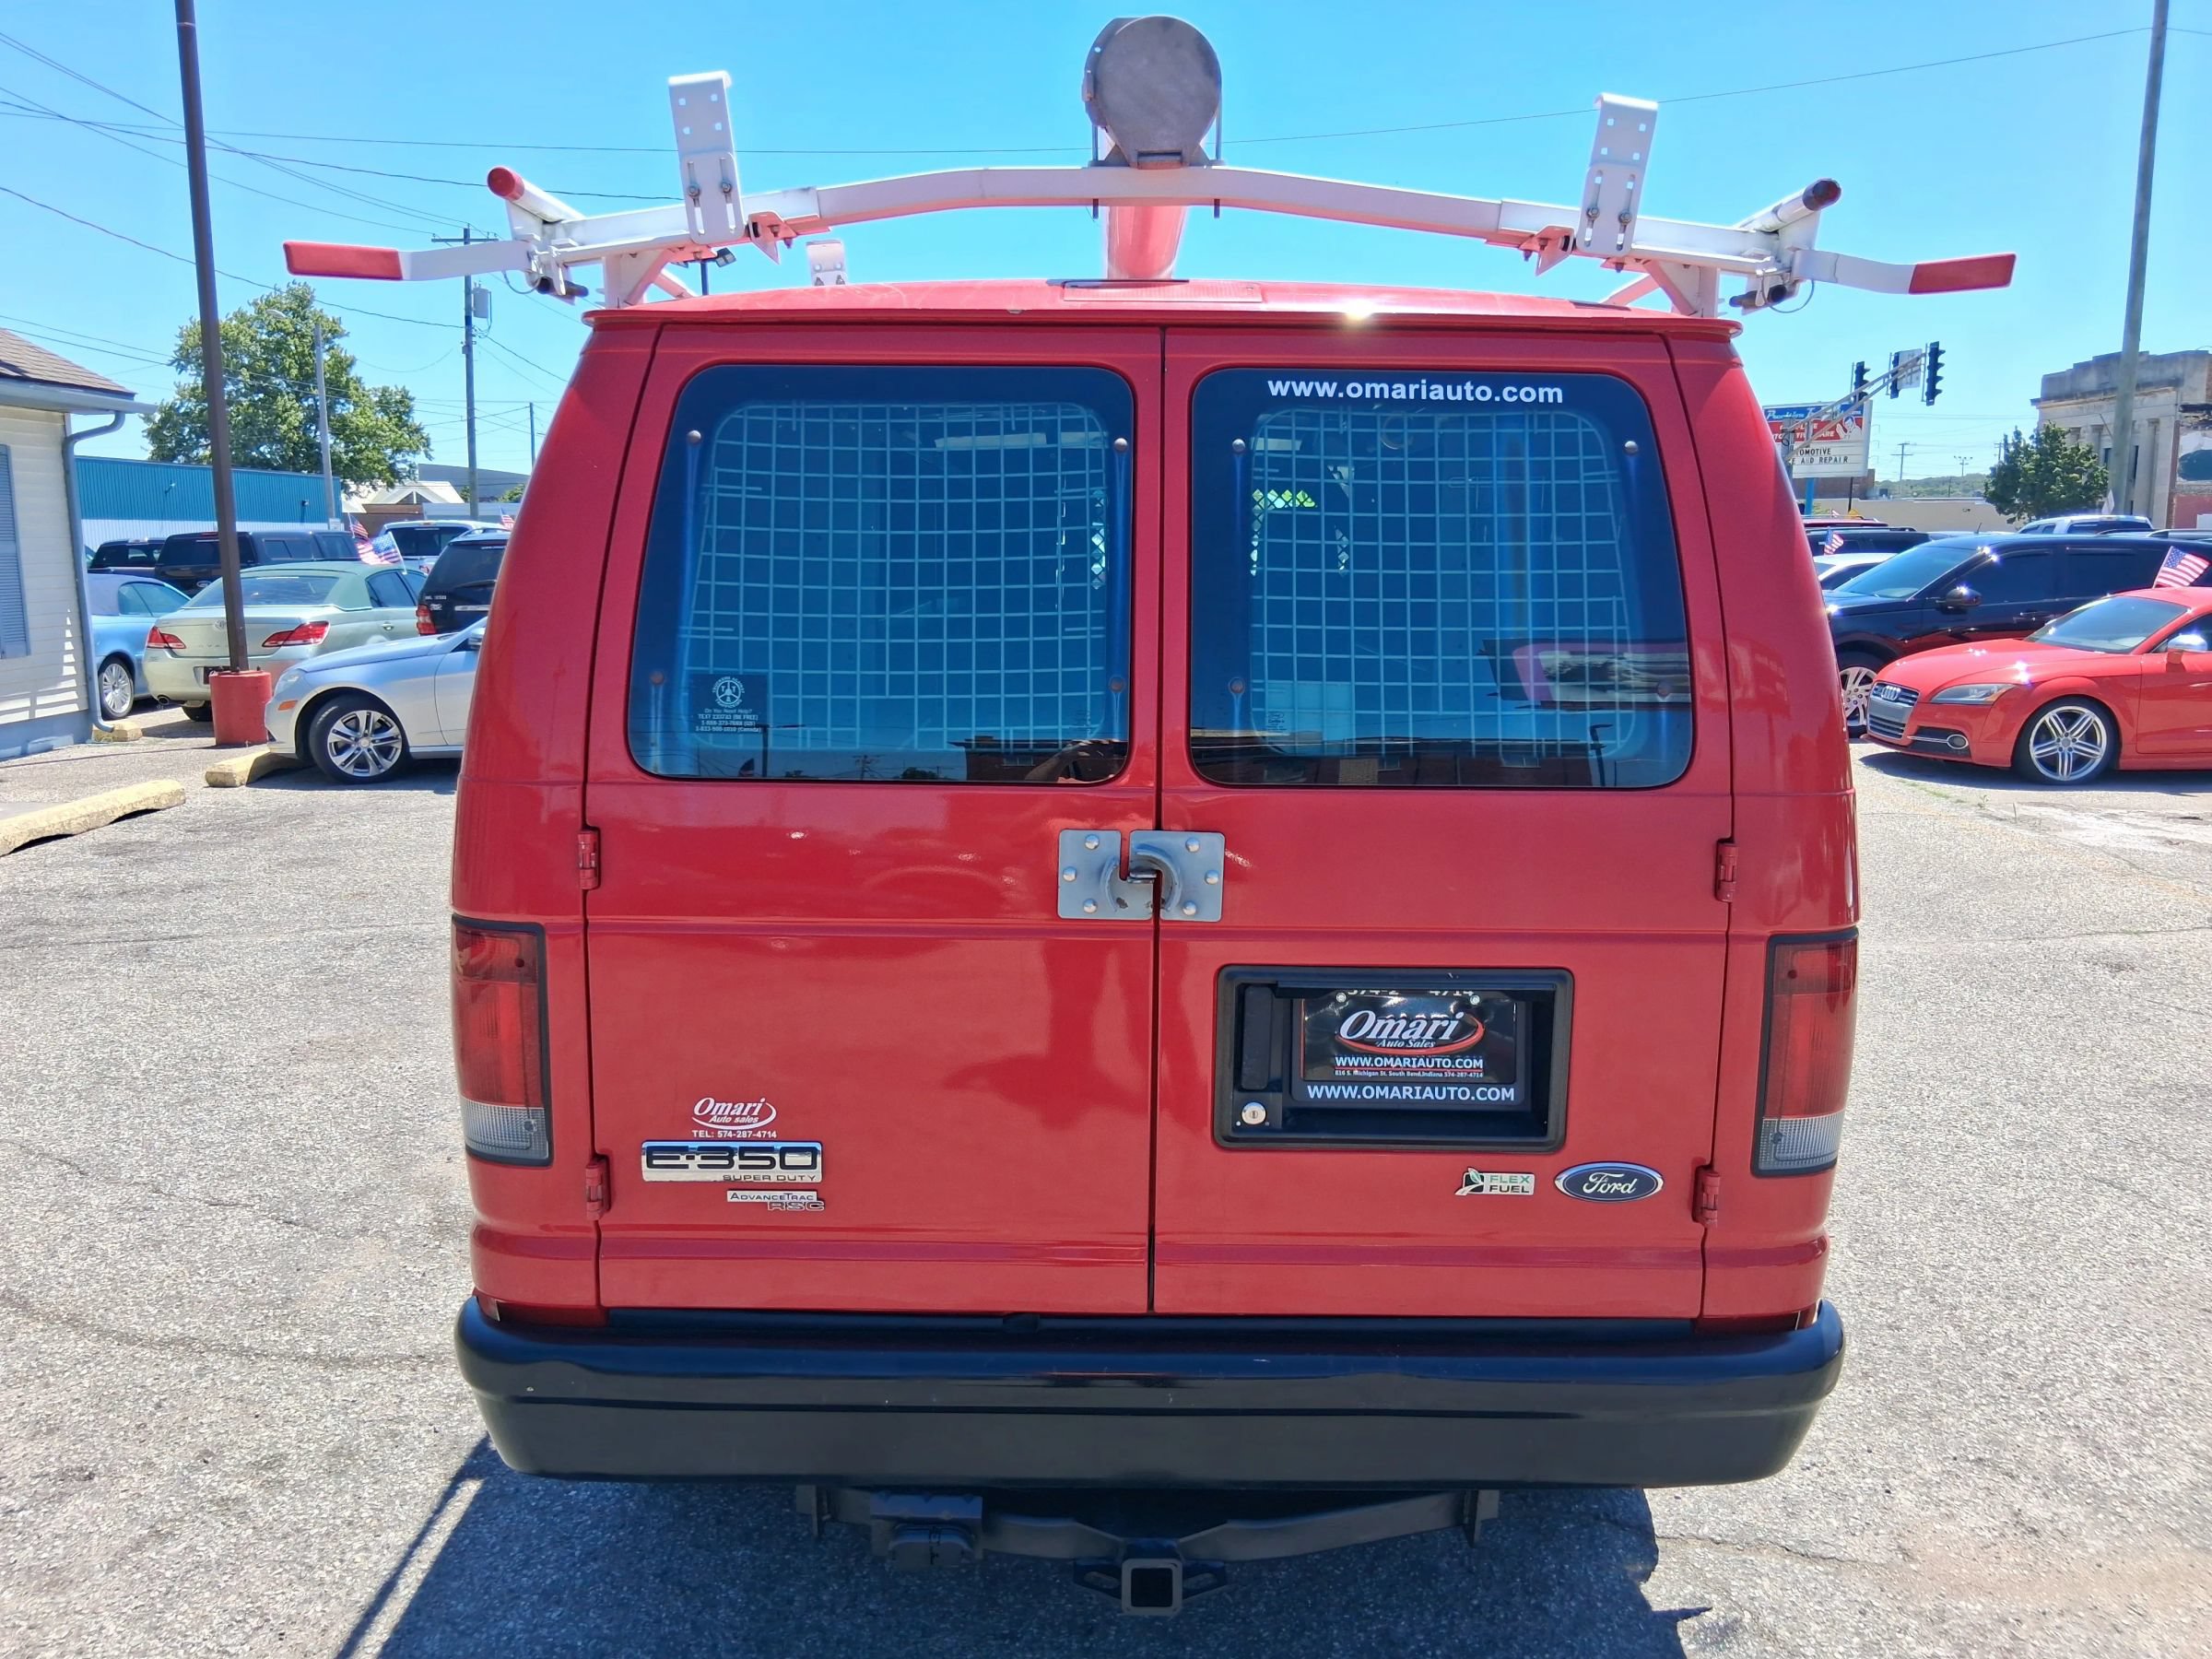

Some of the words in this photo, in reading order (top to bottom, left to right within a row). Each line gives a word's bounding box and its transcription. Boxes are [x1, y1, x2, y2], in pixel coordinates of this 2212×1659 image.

[1267, 378, 1563, 404] www.omariauto.com
[1818, 455, 1849, 465] REPAIR
[1339, 1010, 1465, 1040] Omari
[1377, 1039, 1405, 1048] Auto
[1406, 1039, 1436, 1048] Sales
[1335, 1056, 1483, 1069] WWW.OMARIAUTO.COM
[1307, 1084, 1515, 1101] WWW.OMARIAUTO.COM
[693, 1097, 766, 1117] Omari
[717, 1130, 778, 1139] 574-287-4714
[645, 1145, 818, 1171] E-350
[1489, 1175, 1531, 1183] FLEX
[1583, 1171, 1638, 1194] Ford
[1488, 1185, 1530, 1194] FUEL
[767, 1201, 825, 1211] RSC
